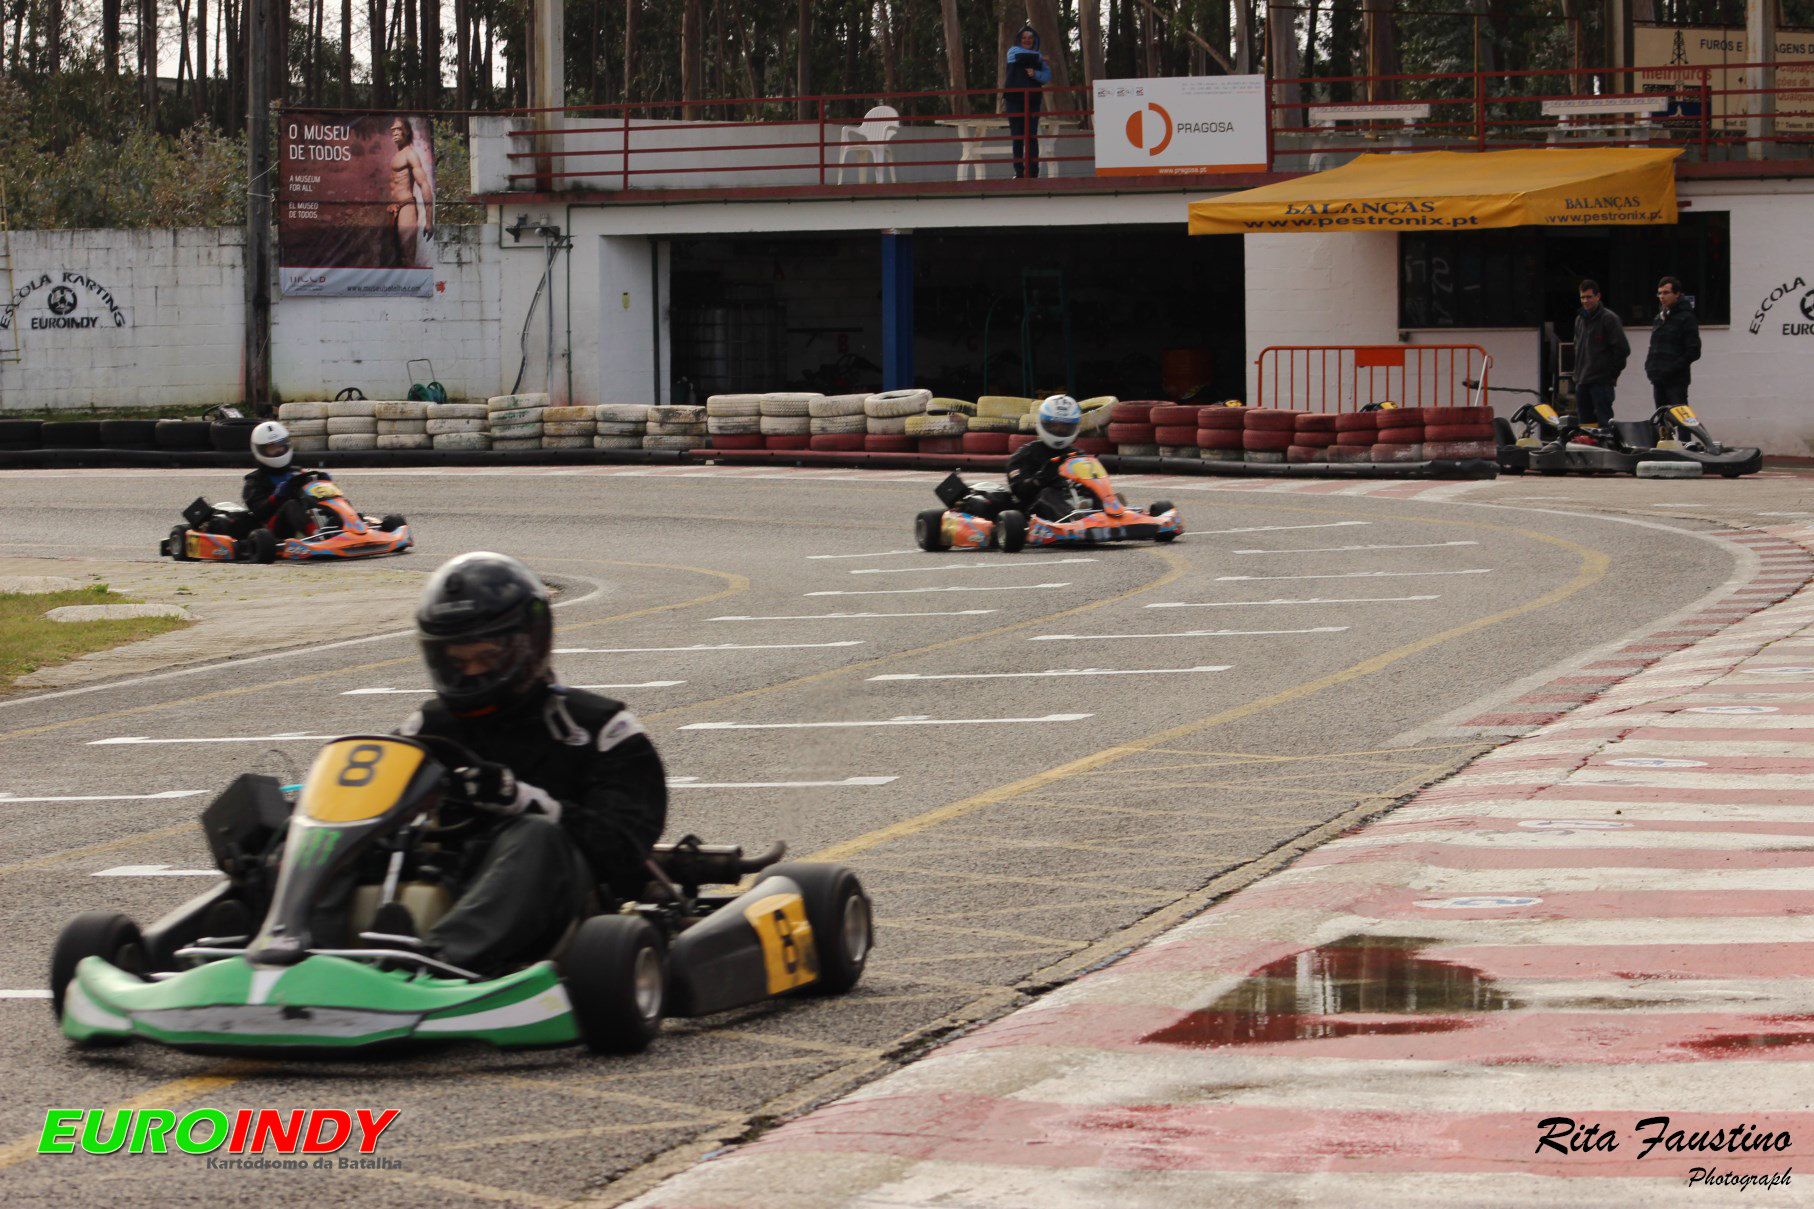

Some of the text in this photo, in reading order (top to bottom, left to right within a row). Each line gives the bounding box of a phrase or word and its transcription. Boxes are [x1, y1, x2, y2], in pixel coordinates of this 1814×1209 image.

[1700, 39, 1733, 51] FUROS
[1736, 41, 1743, 52] E
[1775, 43, 1806, 54] AGENS
[289, 123, 350, 141] O MUSEU
[1177, 122, 1235, 134] PRAGOSA
[289, 144, 352, 161] DE TODOS
[1158, 166, 1207, 176] www.pragosa.pt
[289, 175, 321, 183] A MUSEUM
[289, 183, 313, 192] FOR ALL
[289, 201, 319, 210] EL MUSEO
[1285, 201, 1435, 217] BALANÇAS
[1564, 196, 1641, 210] BALANÇAS
[289, 210, 318, 219] DE TODOS
[1243, 215, 1479, 228] www.pestronix.pt
[0, 274, 52, 330] ESCOLA
[62, 272, 126, 328] KARTING
[1749, 277, 1806, 335] ESCOLA
[31, 316, 99, 330] EUROINDY
[337, 744, 385, 788] 8
